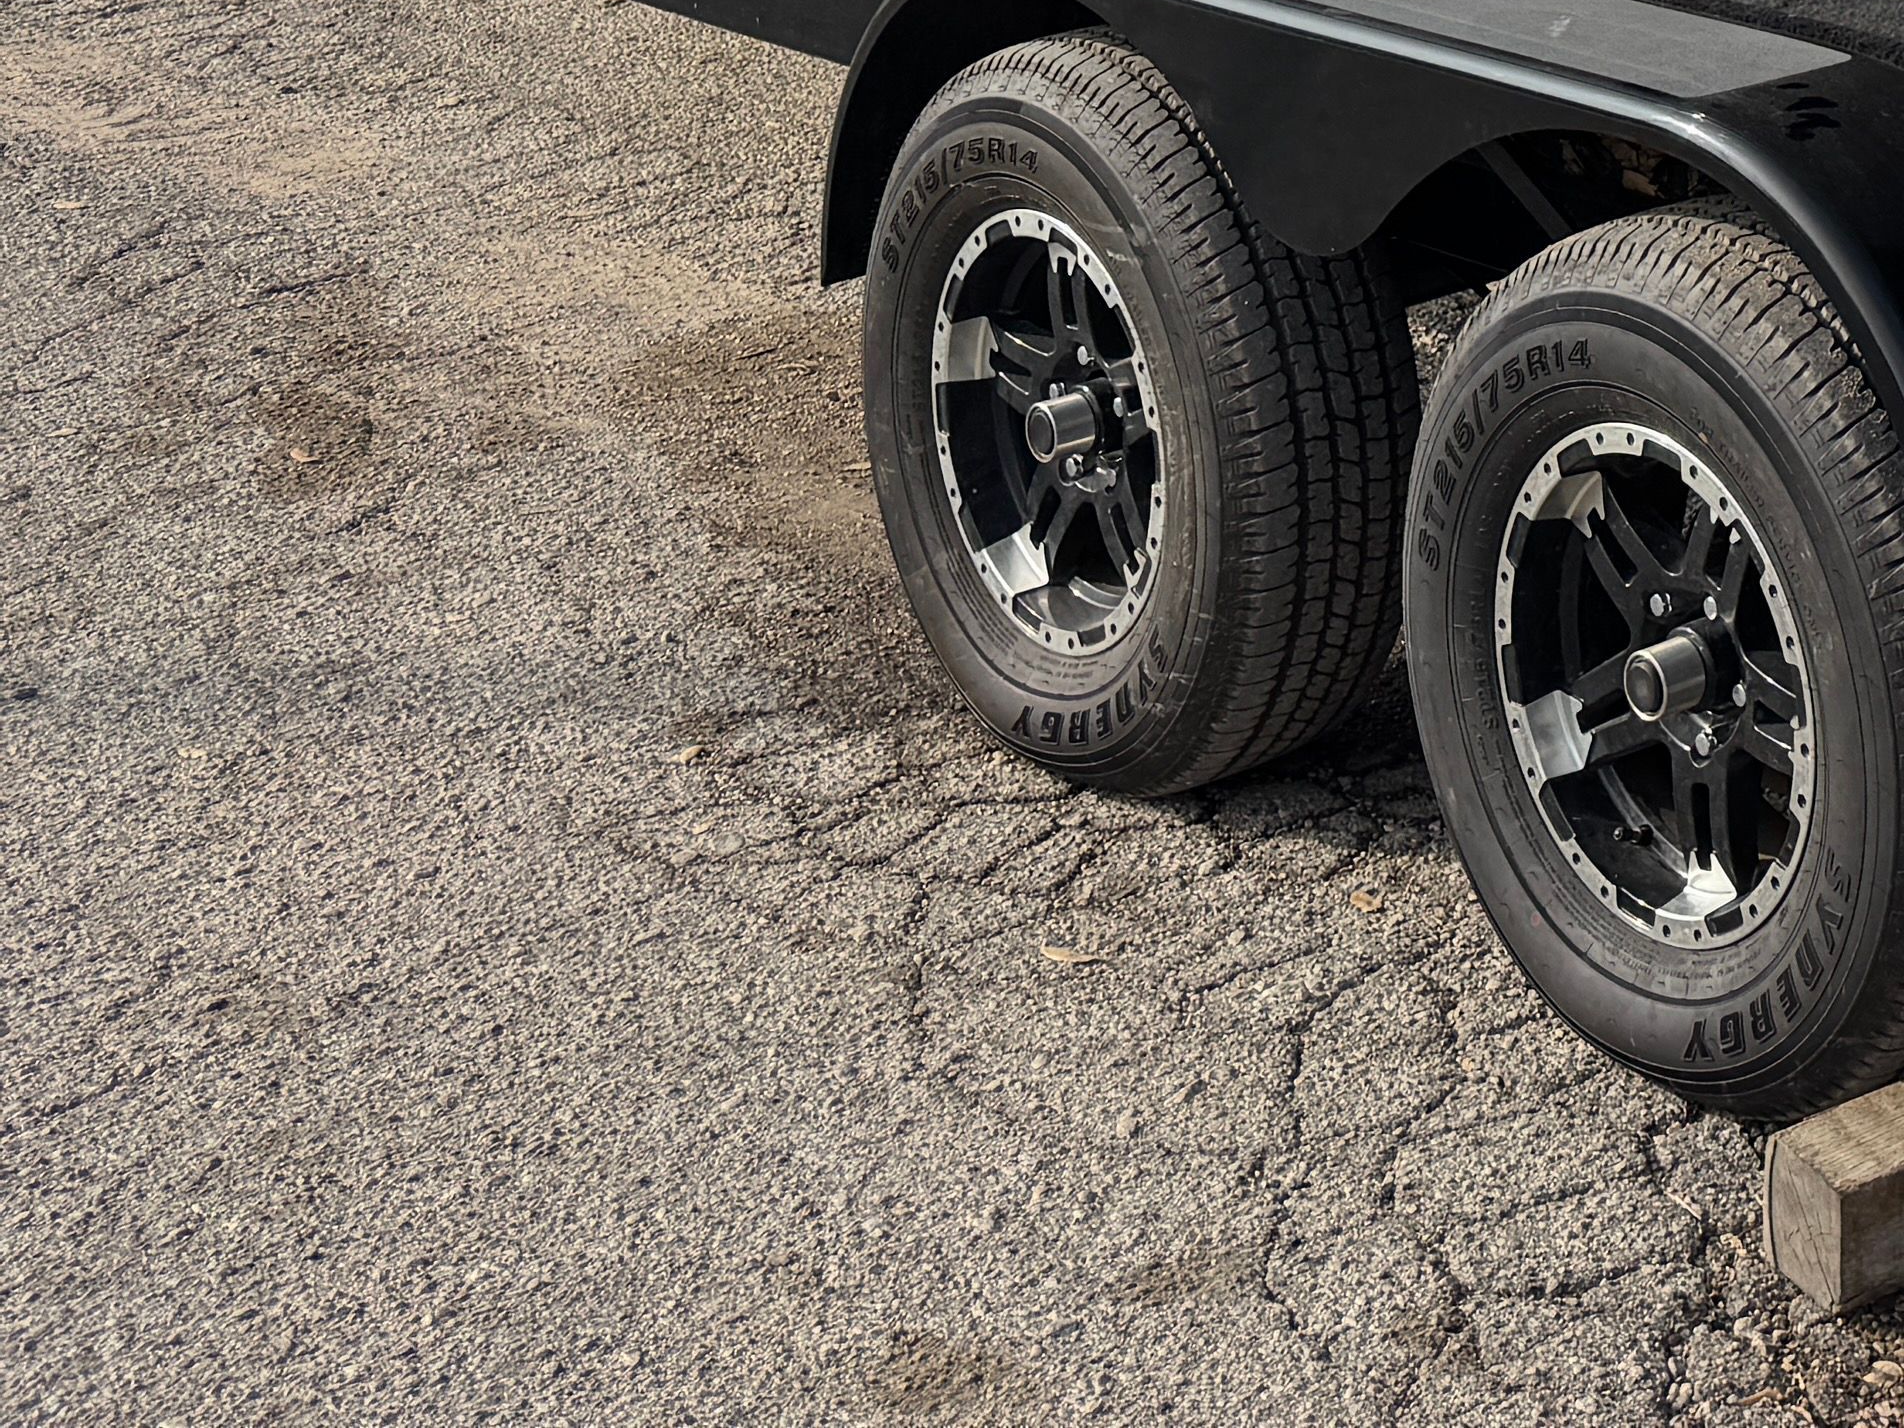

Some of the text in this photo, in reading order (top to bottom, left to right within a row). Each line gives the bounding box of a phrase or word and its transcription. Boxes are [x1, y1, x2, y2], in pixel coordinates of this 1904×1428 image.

[1418, 337, 1593, 572] ST215/75R14
[1010, 622, 1169, 747] SYNERGY
[1682, 846, 1852, 1063] SYNERGY
